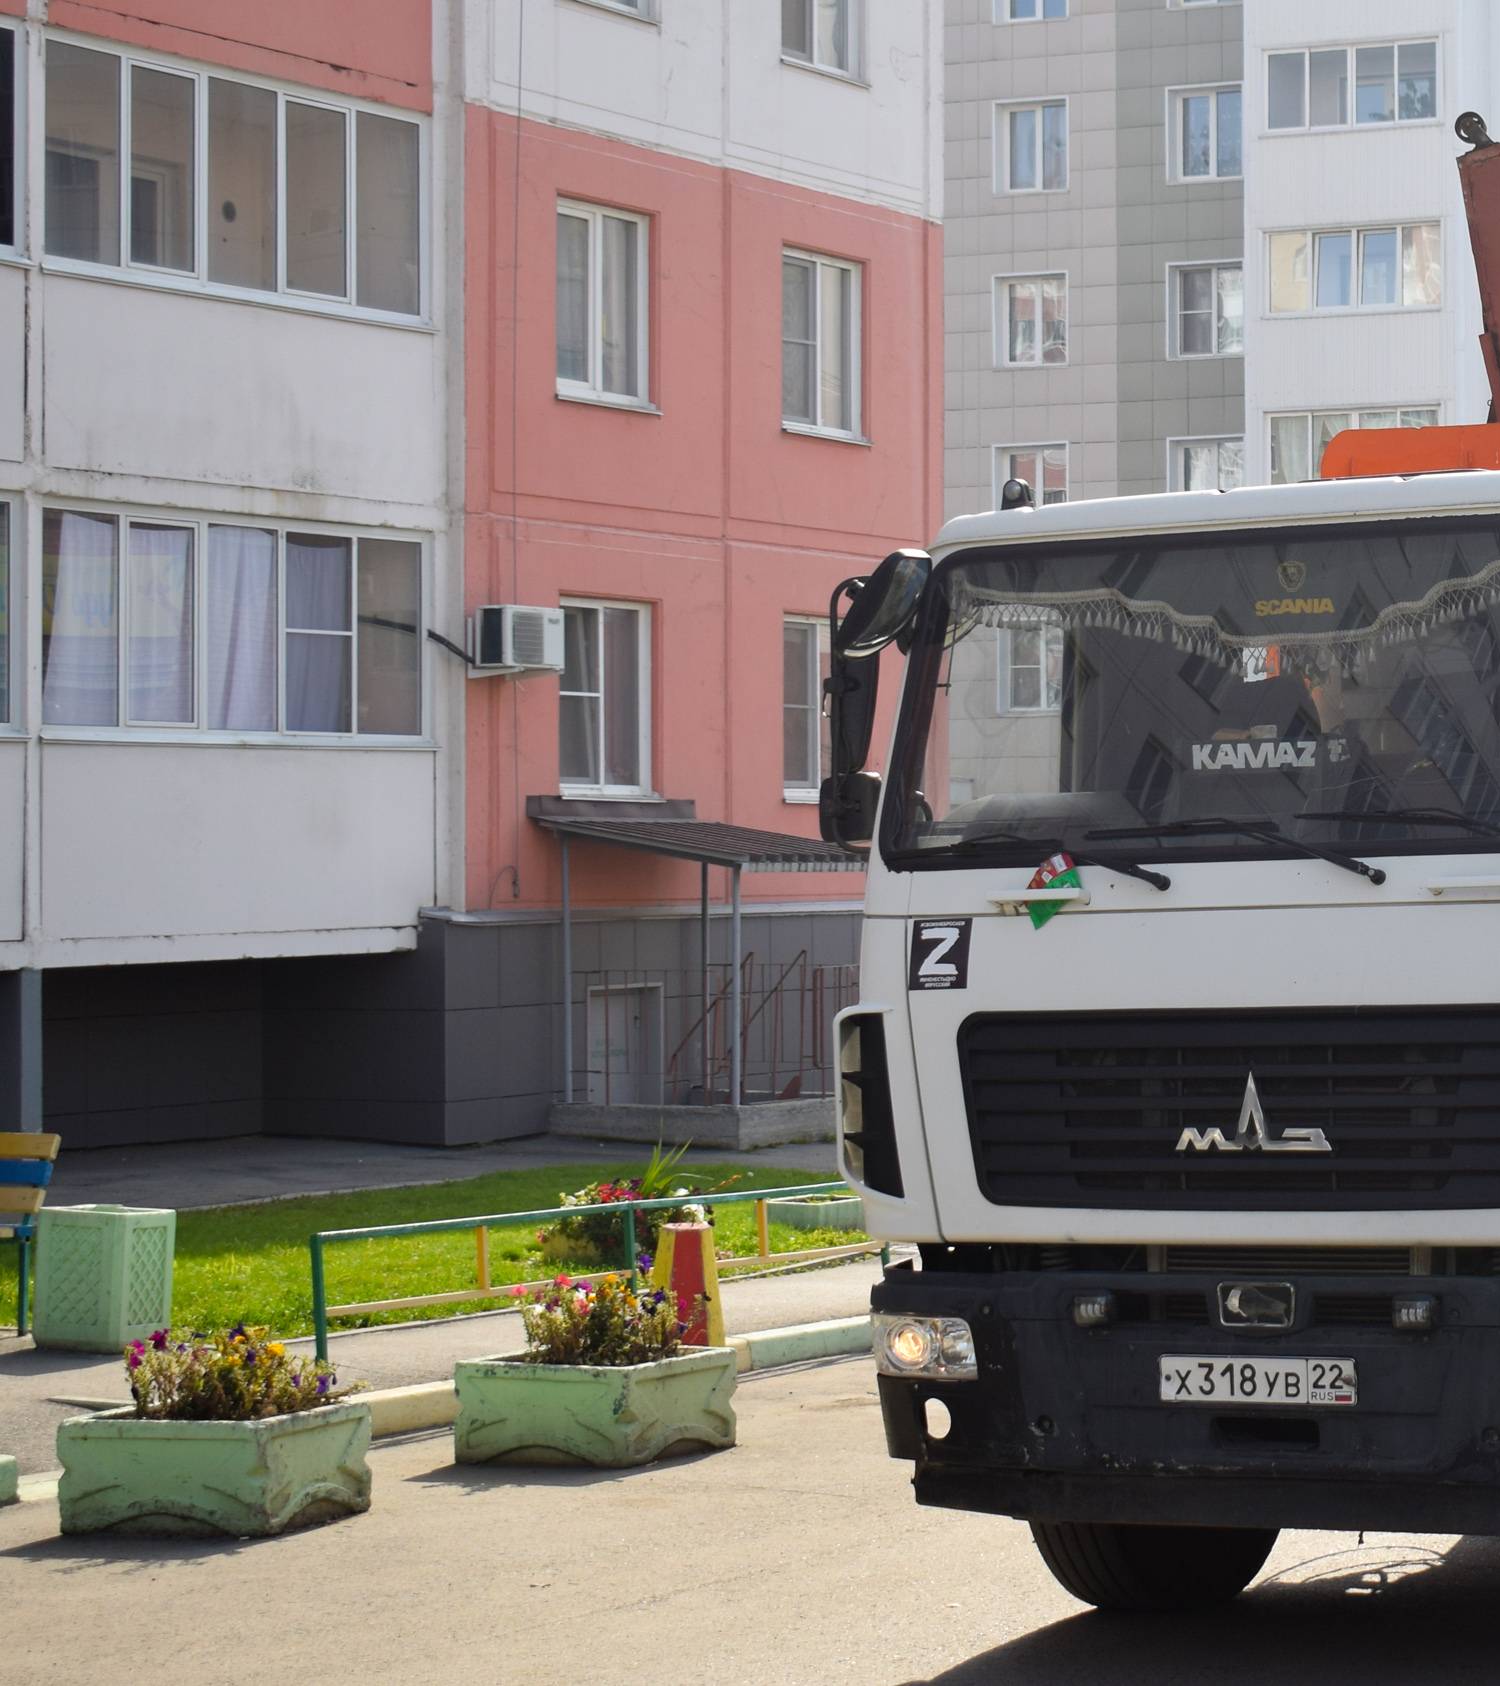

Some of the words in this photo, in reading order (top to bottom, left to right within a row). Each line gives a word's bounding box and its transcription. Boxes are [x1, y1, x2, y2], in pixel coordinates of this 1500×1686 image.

[1255, 598, 1335, 616] SCANIA
[1192, 741, 1317, 770] KAMAZ
[918, 927, 960, 976] Z
[1311, 1391, 1334, 1401] RUS
